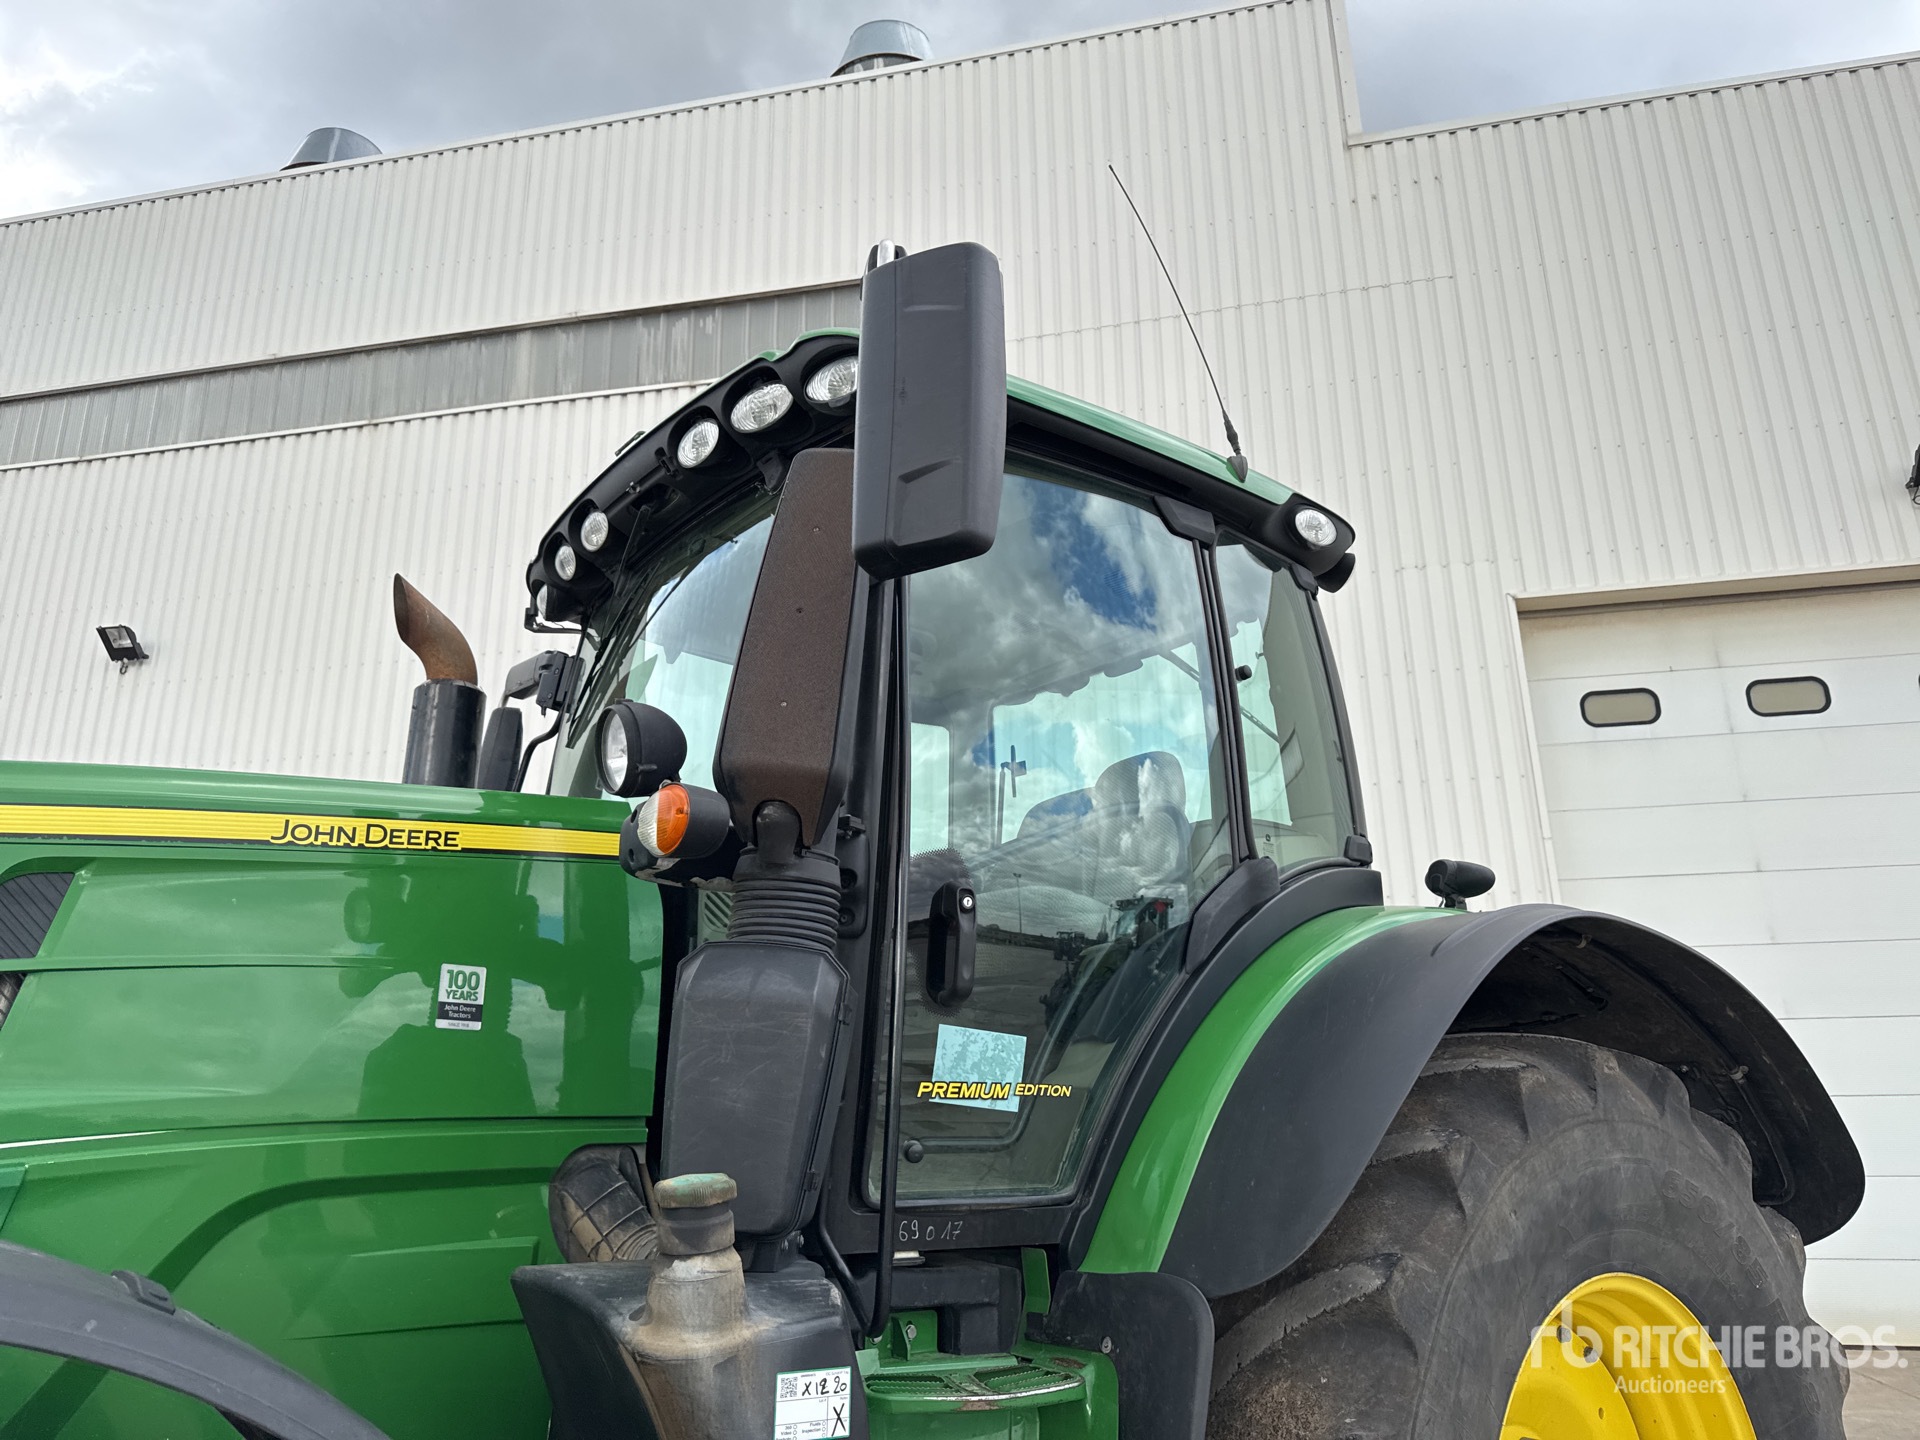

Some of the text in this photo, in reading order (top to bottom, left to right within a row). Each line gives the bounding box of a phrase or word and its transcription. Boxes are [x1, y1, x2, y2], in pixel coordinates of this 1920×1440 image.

[270, 819, 460, 847] JOHN DEERE
[447, 969, 480, 991] 100
[445, 989, 479, 1002] YEARS
[459, 1005, 476, 1013] Deere
[916, 1081, 1072, 1100] PREMIUM EDITION
